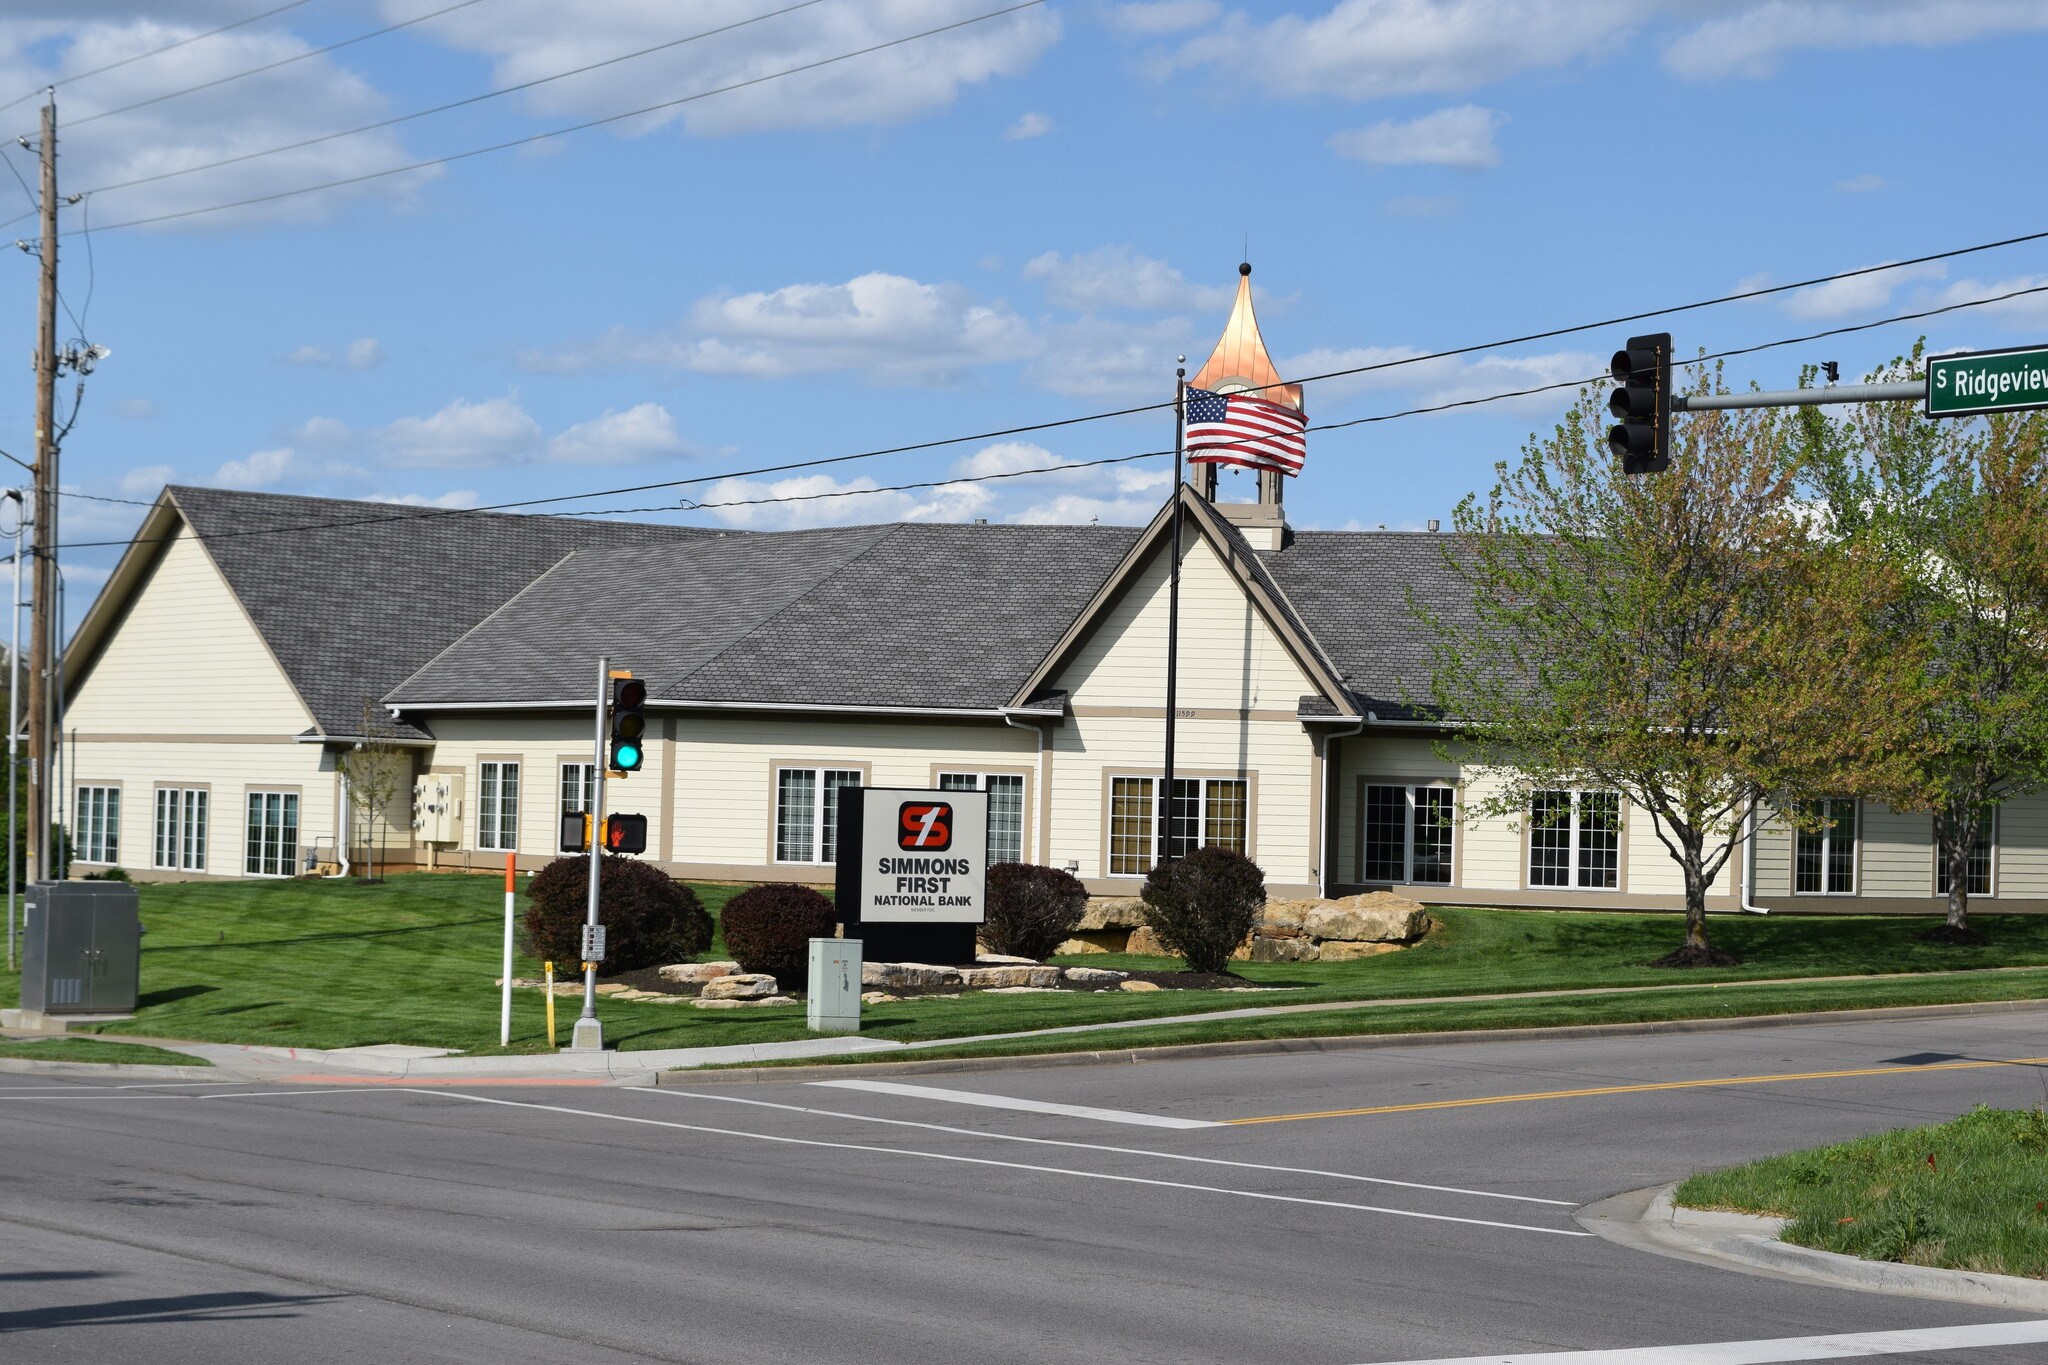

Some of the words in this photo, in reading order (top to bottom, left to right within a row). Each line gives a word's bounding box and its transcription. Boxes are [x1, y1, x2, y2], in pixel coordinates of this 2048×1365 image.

[1936, 368, 1947, 389] S
[878, 857, 970, 875] SIMMONS
[896, 877, 951, 893] FIRST
[874, 895, 935, 906] NATIONAL
[938, 896, 972, 907] BANK
